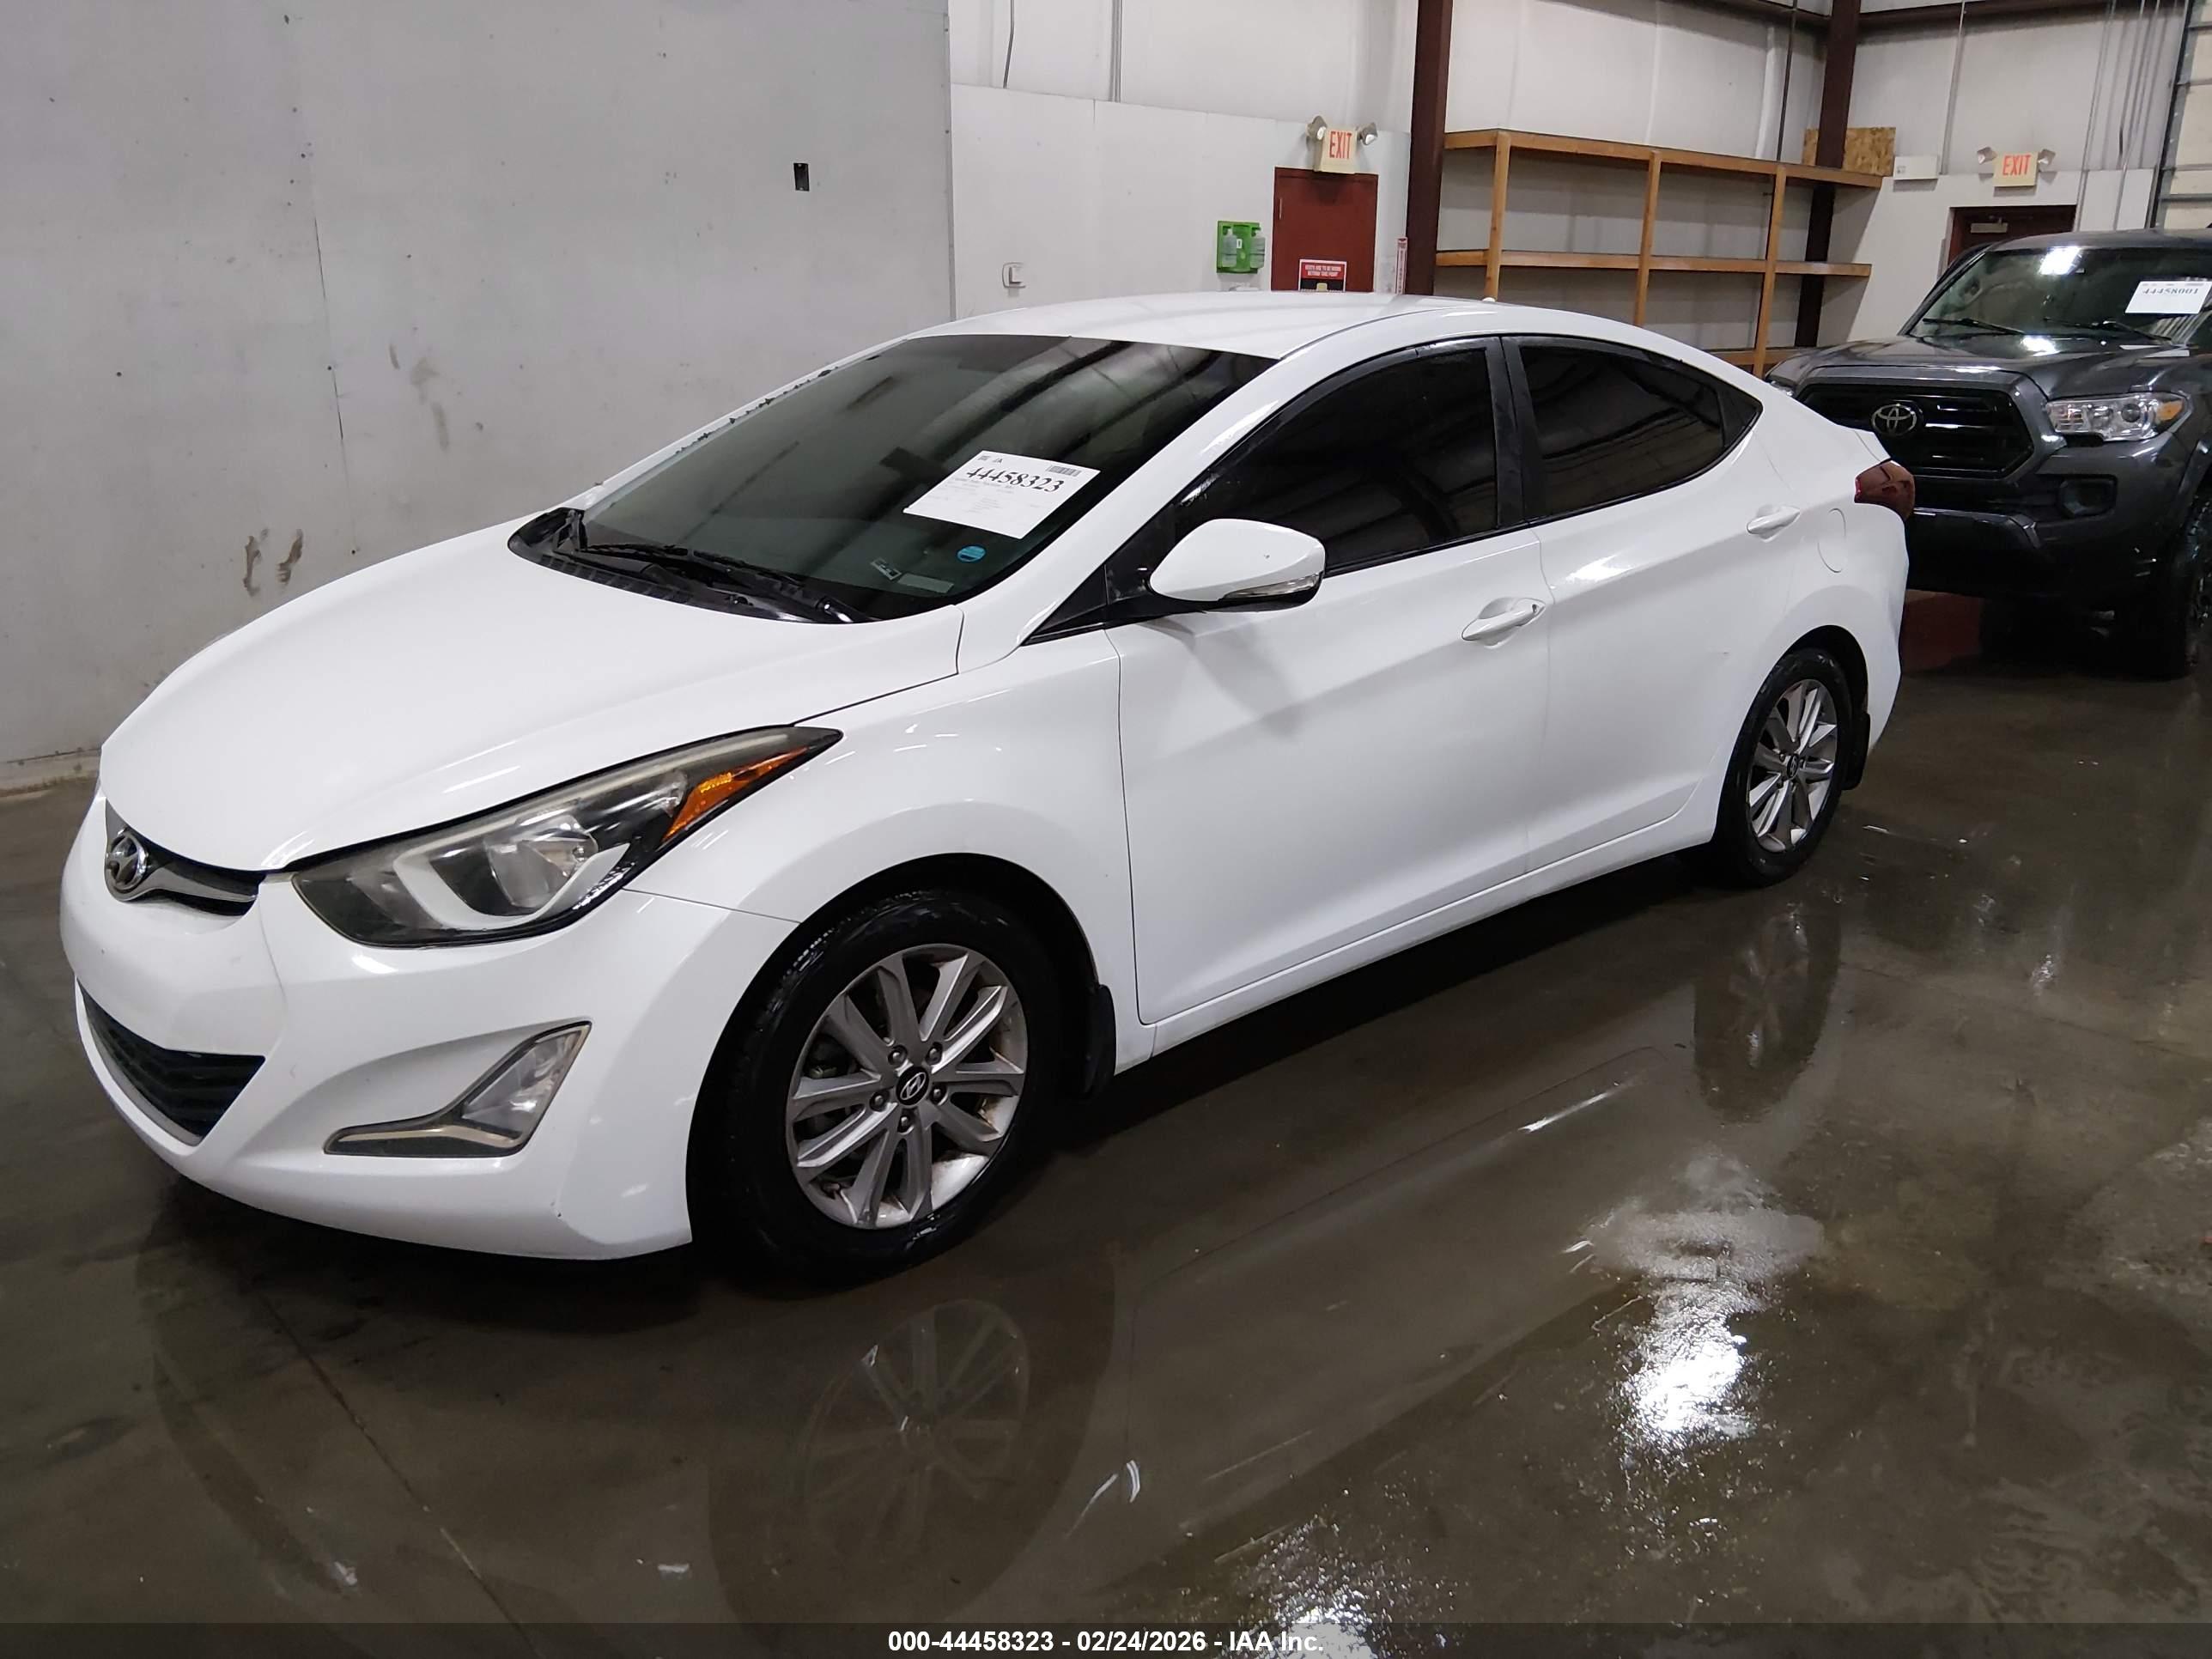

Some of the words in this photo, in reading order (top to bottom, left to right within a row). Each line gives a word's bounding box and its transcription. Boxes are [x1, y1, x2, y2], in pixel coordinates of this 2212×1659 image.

[1329, 131, 1352, 159] EXIT
[2002, 155, 2031, 176] EXIT
[966, 466, 1065, 493] 44458323
